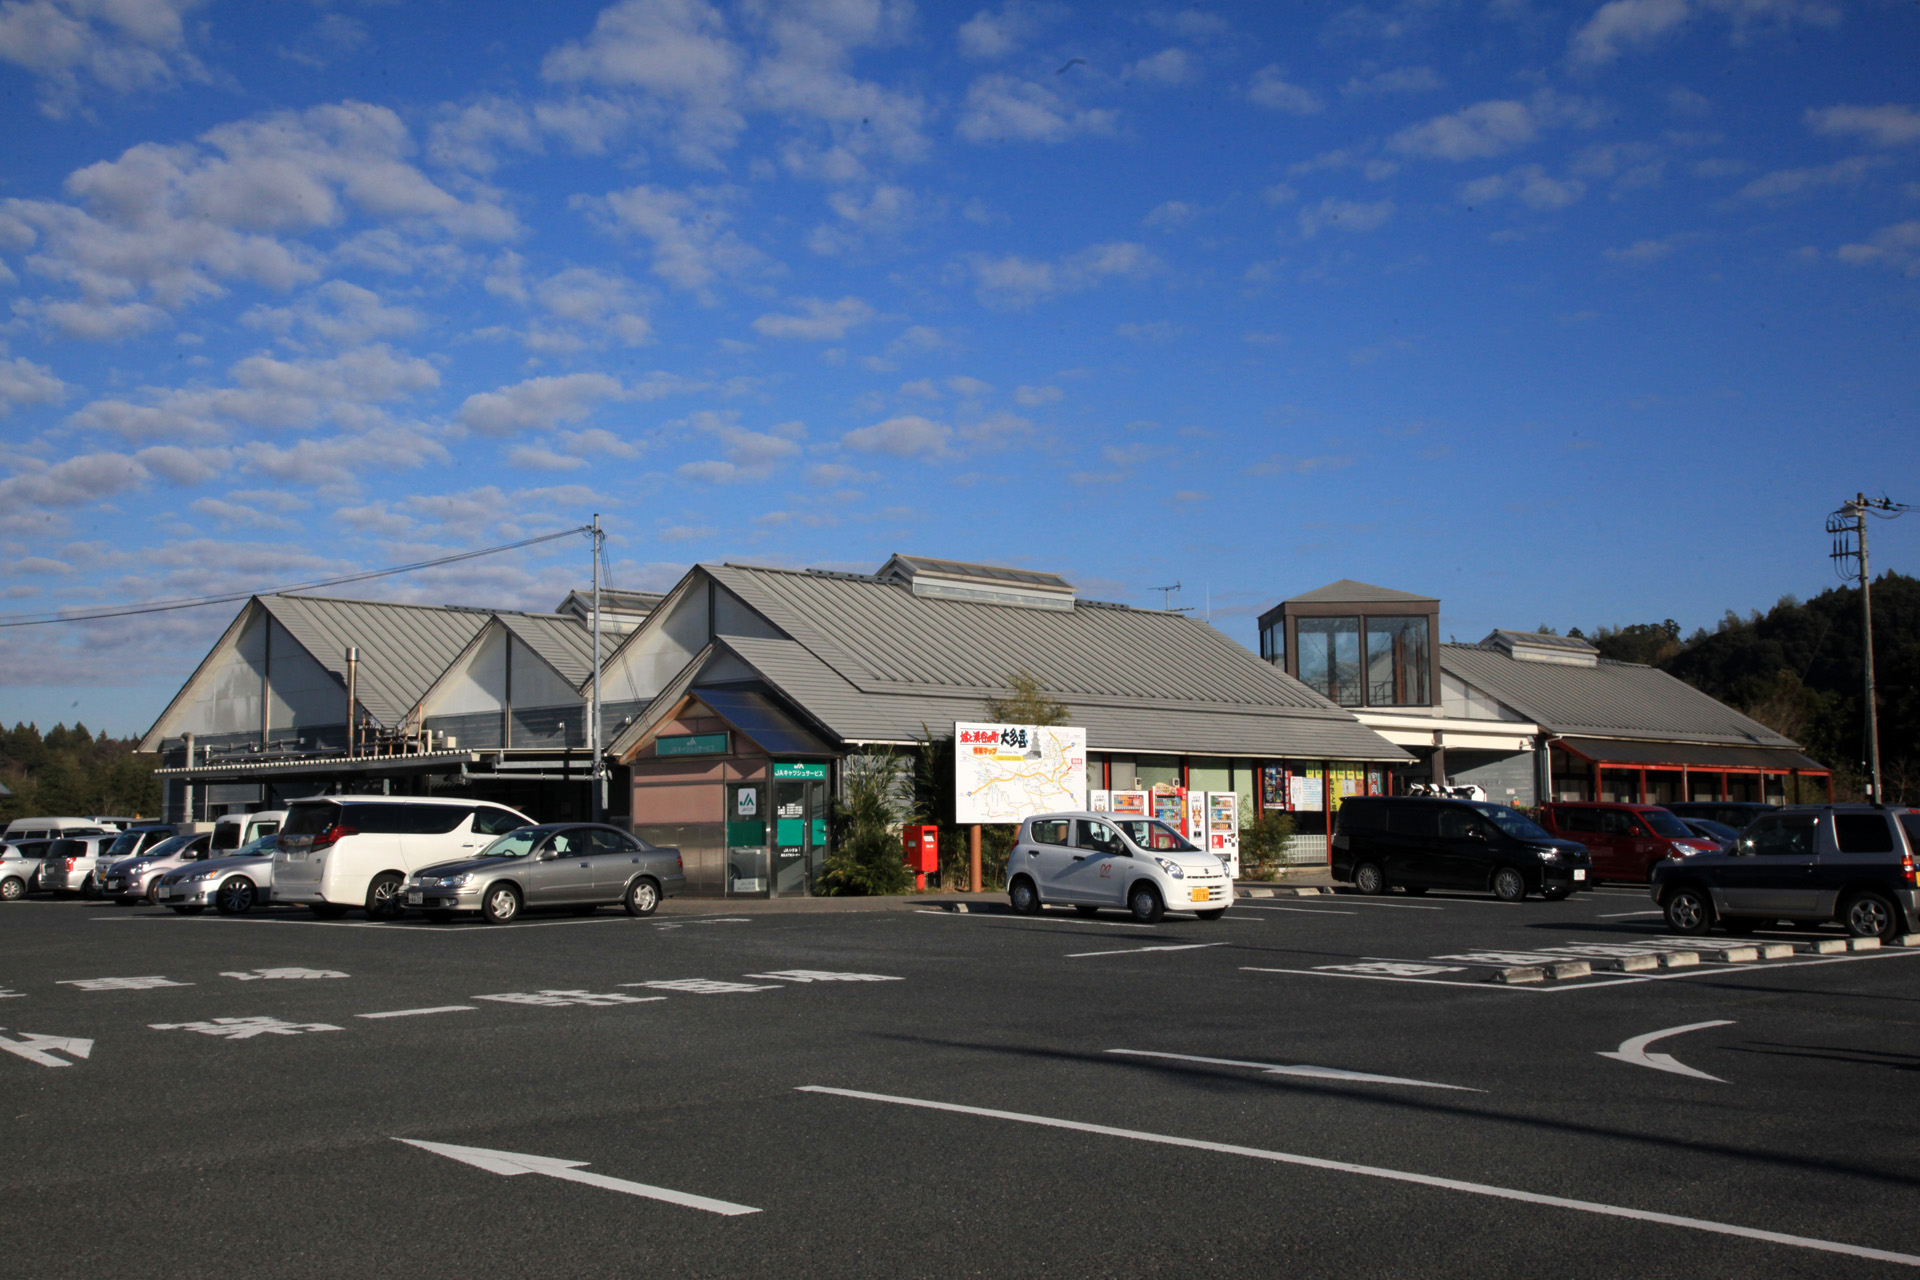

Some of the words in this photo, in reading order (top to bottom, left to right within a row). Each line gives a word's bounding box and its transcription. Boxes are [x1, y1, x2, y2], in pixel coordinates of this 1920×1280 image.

[1000, 727, 1028, 748] 大多喜
[973, 746, 998, 755] 情報マップ
[774, 769, 824, 777] JAキャッシュサービス
